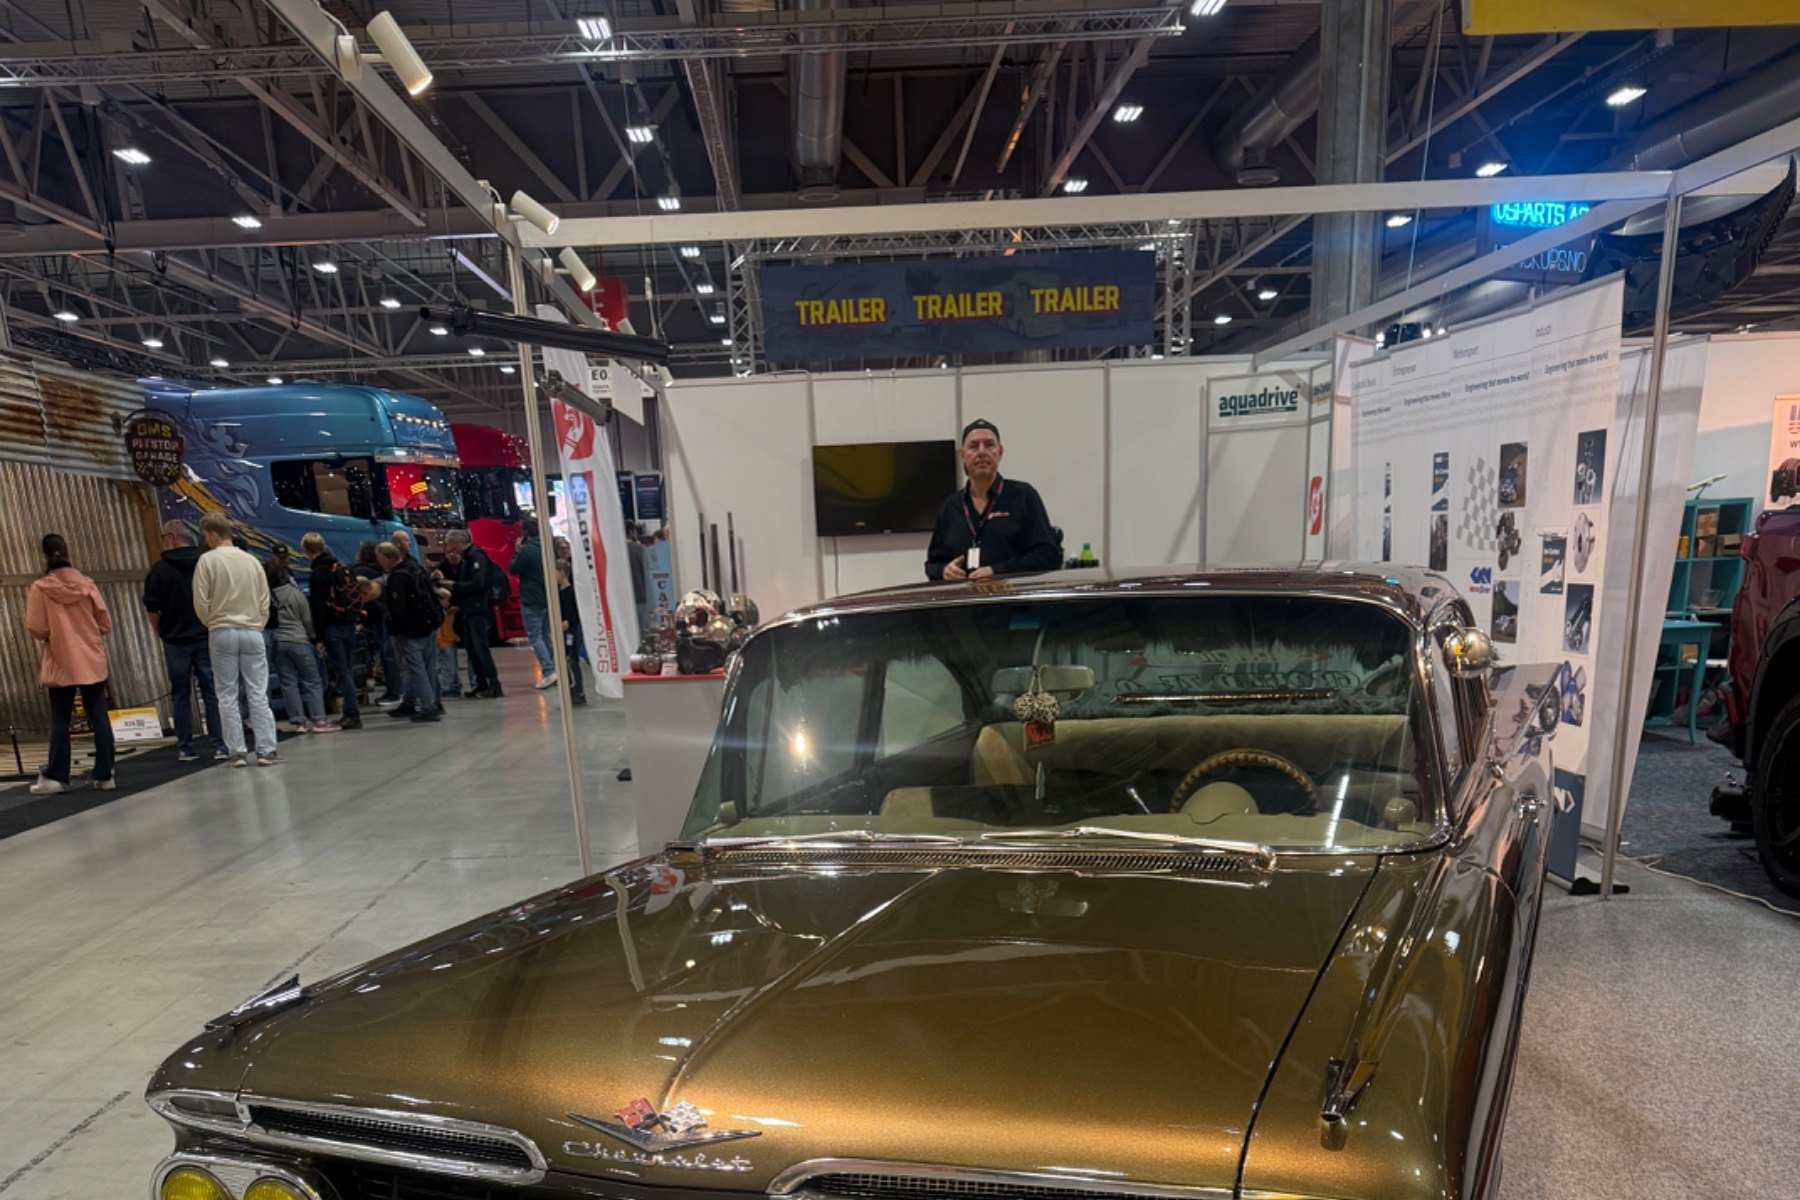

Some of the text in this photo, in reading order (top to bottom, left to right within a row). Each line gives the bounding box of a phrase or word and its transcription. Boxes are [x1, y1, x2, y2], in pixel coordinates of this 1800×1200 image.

[796, 297, 887, 326] TRAILER
[913, 290, 1004, 321] TRAILER
[1030, 285, 1121, 315] TRAILER
[1218, 386, 1298, 416] aquadrive
[131, 438, 179, 452] PITSTOP
[135, 451, 178, 463] GARAGE
[563, 1141, 754, 1172] Chevrolet
